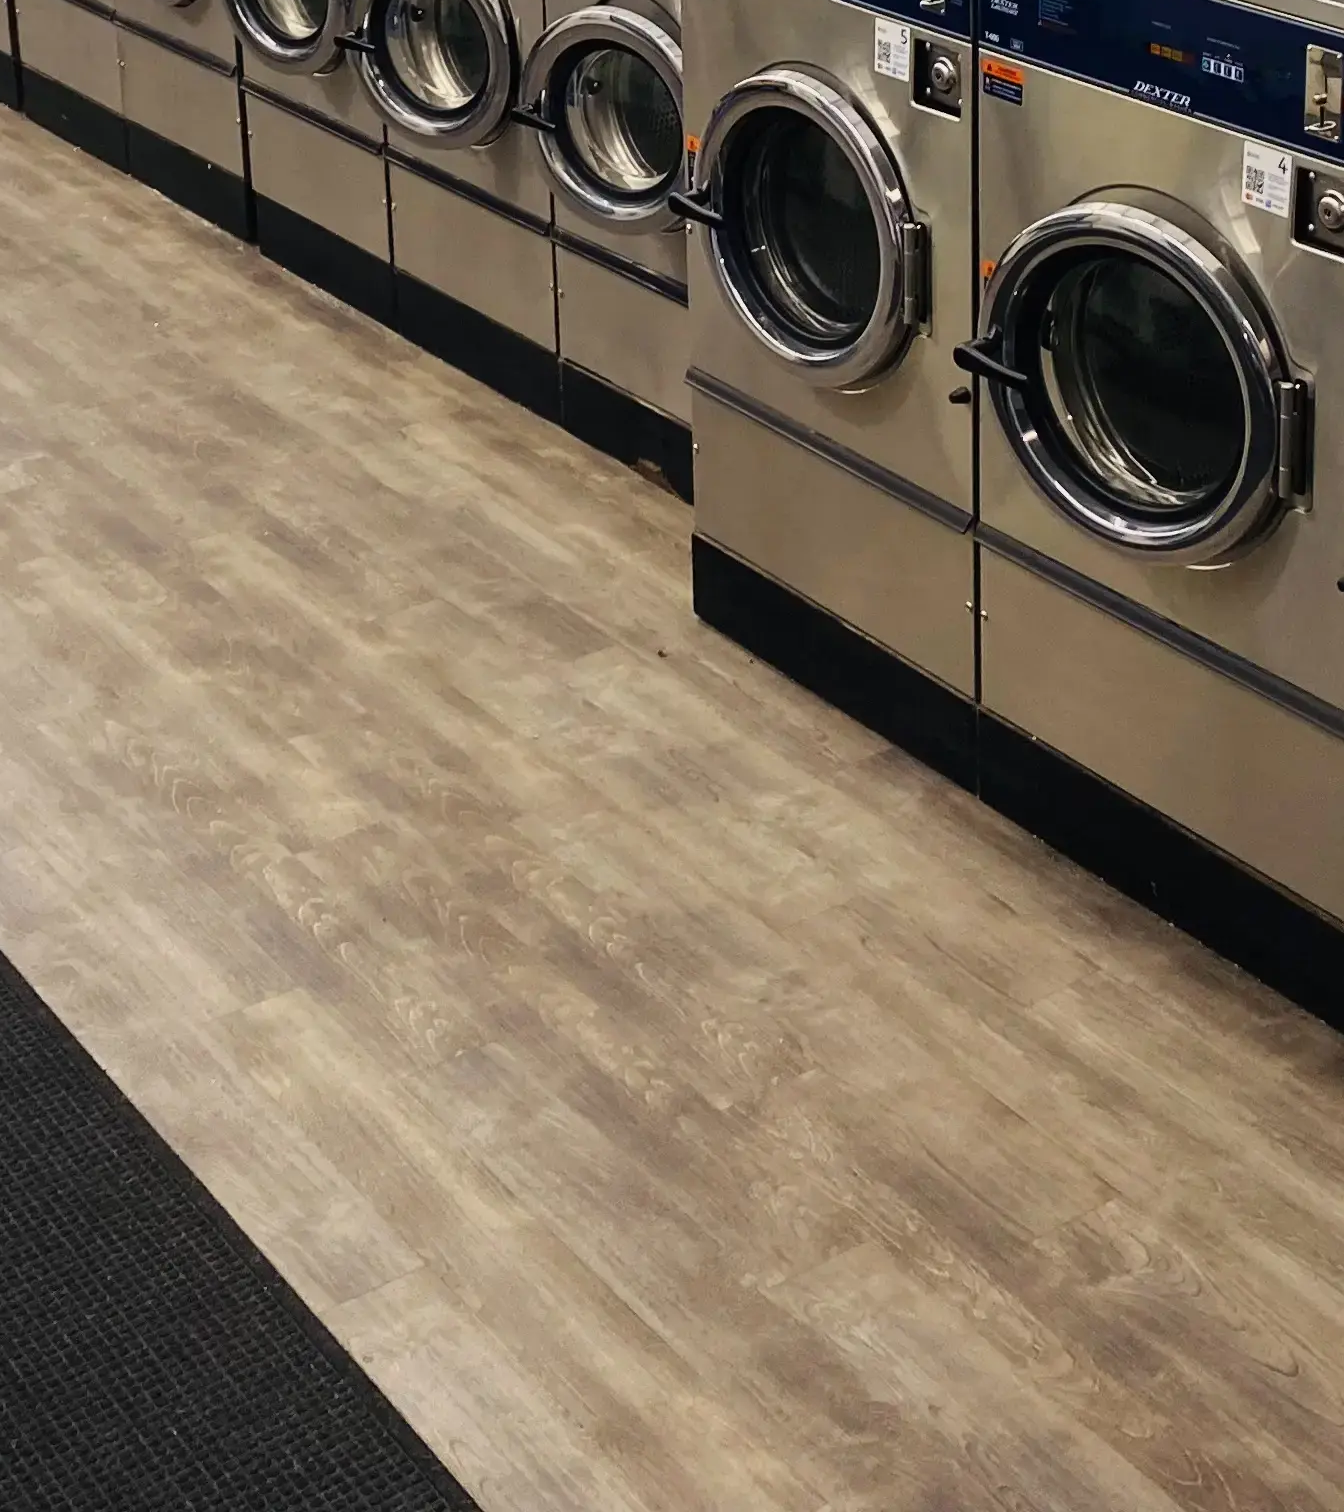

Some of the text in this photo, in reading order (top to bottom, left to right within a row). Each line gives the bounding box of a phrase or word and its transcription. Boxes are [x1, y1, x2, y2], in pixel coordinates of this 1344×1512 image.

[900, 28, 908, 45] 5
[1133, 80, 1191, 107] DEXTER
[1277, 156, 1289, 175] 4
